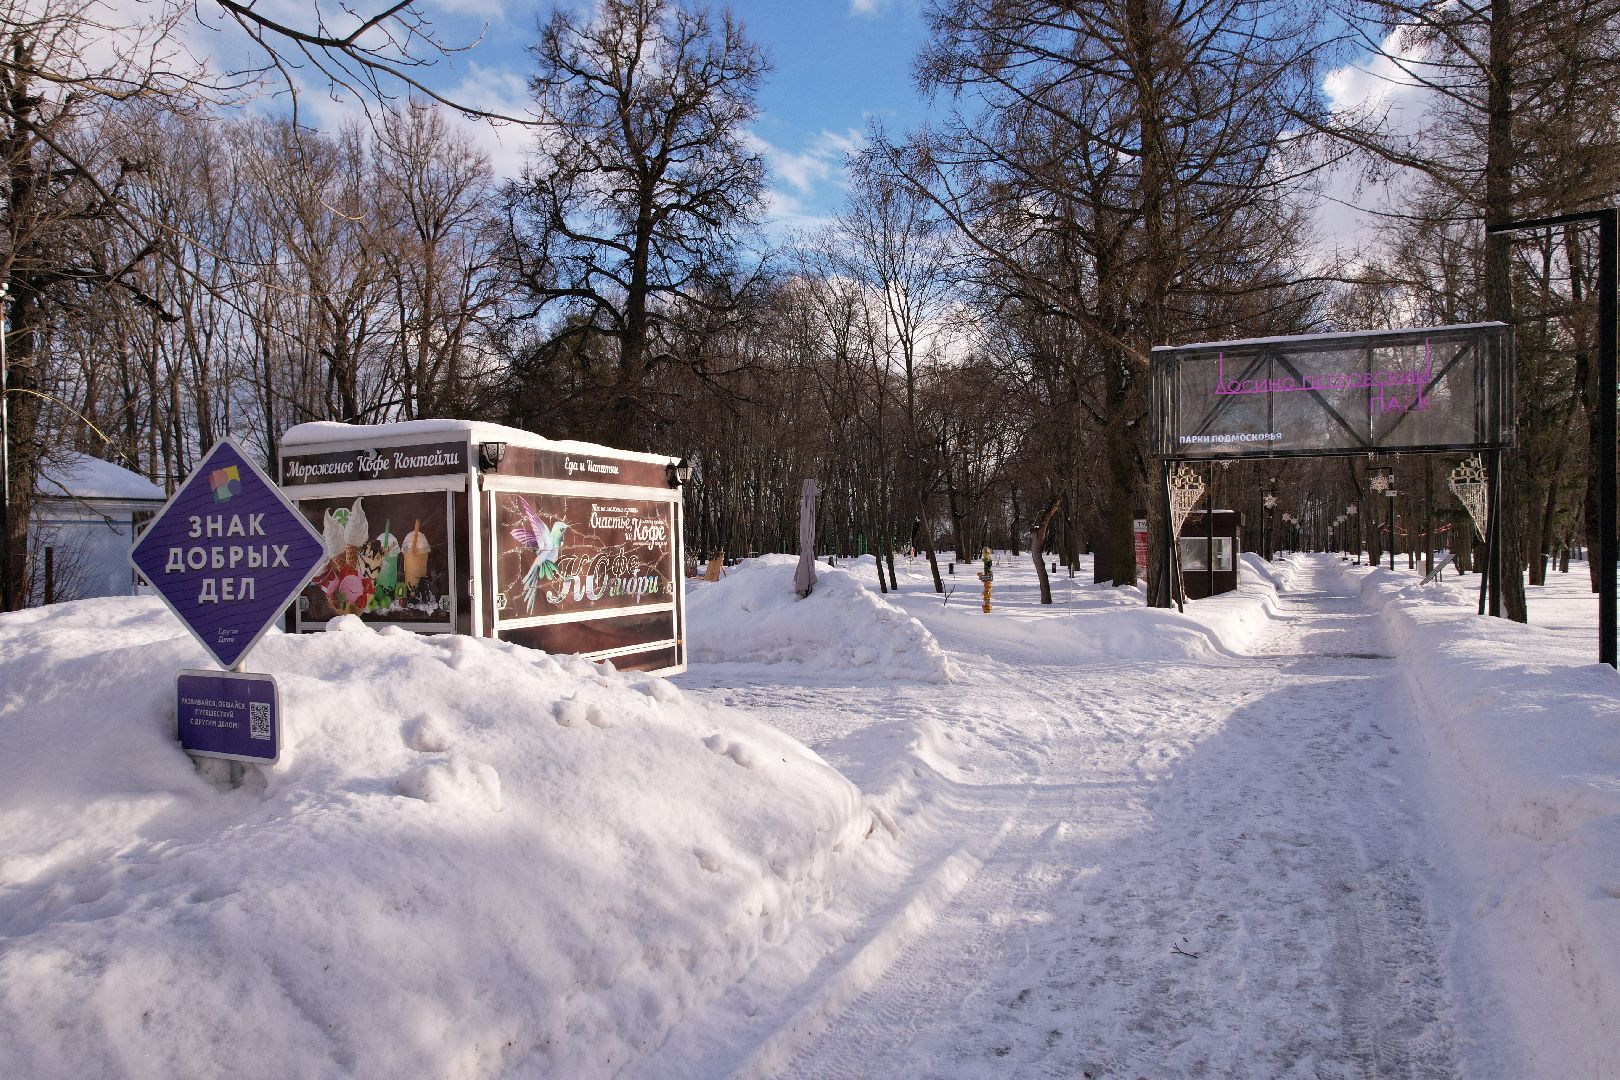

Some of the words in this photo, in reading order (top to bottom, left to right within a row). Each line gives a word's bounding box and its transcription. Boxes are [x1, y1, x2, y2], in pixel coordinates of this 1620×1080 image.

[1179, 436, 1210, 444] ПАРКИ
[1211, 432, 1282, 443] ПОДМОСКОВЬЯ
[287, 461, 353, 483] Мороженое
[356, 454, 389, 478] Кофе
[393, 450, 460, 471] Коктейли
[565, 456, 579, 476] Еда
[580, 462, 586, 472] и
[188, 513, 267, 538] ЗНАК
[165, 544, 290, 573] ДОБРЫХ
[198, 577, 255, 604] ДЕЛ
